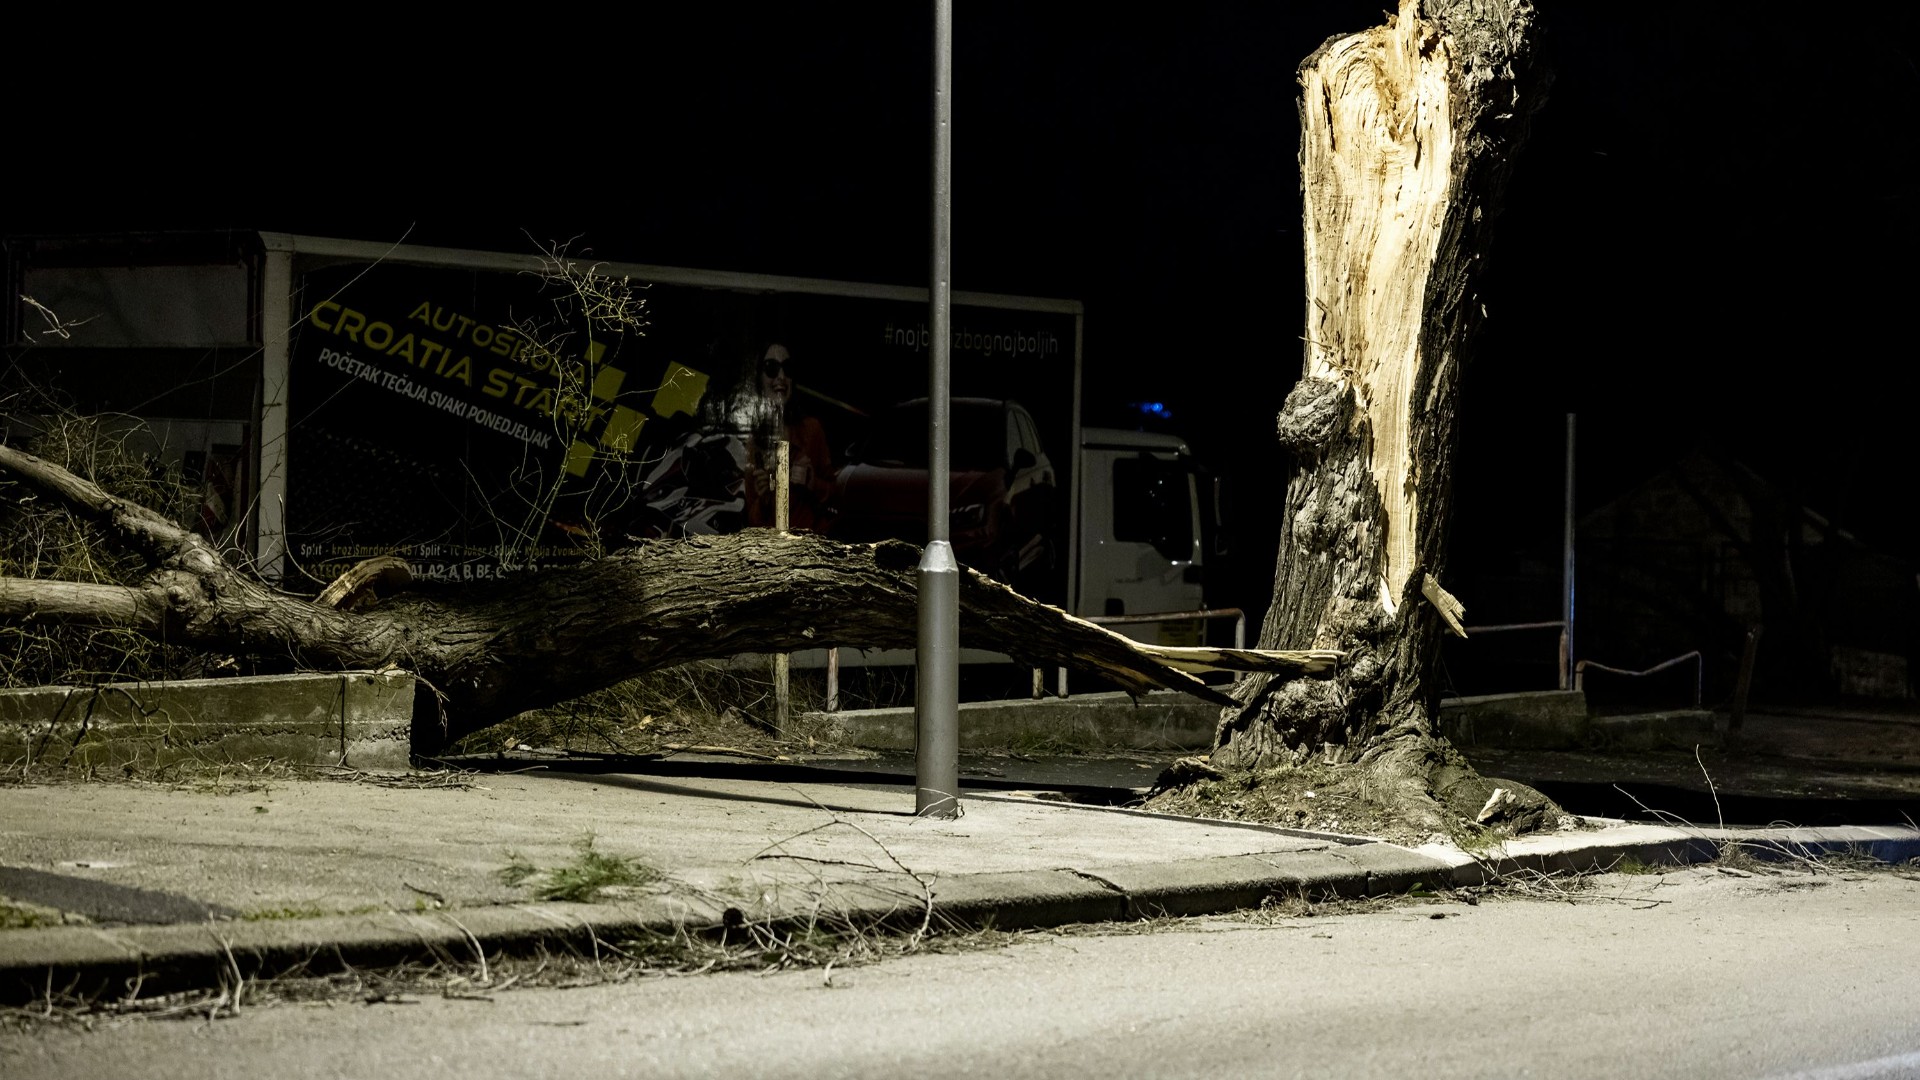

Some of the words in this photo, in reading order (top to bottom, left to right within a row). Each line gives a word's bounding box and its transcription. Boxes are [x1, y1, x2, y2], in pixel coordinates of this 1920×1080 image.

[309, 299, 473, 388] CROATIA
[884, 322, 1058, 359] #najbizbognajboljih
[318, 347, 384, 384] POČETAK
[381, 370, 428, 404] TEČAJA
[427, 389, 467, 419] SVAKI
[467, 404, 553, 450] PONEDJELJAK
[300, 543, 322, 558] Split
[332, 543, 352, 556] kroz
[420, 544, 440, 558] Split
